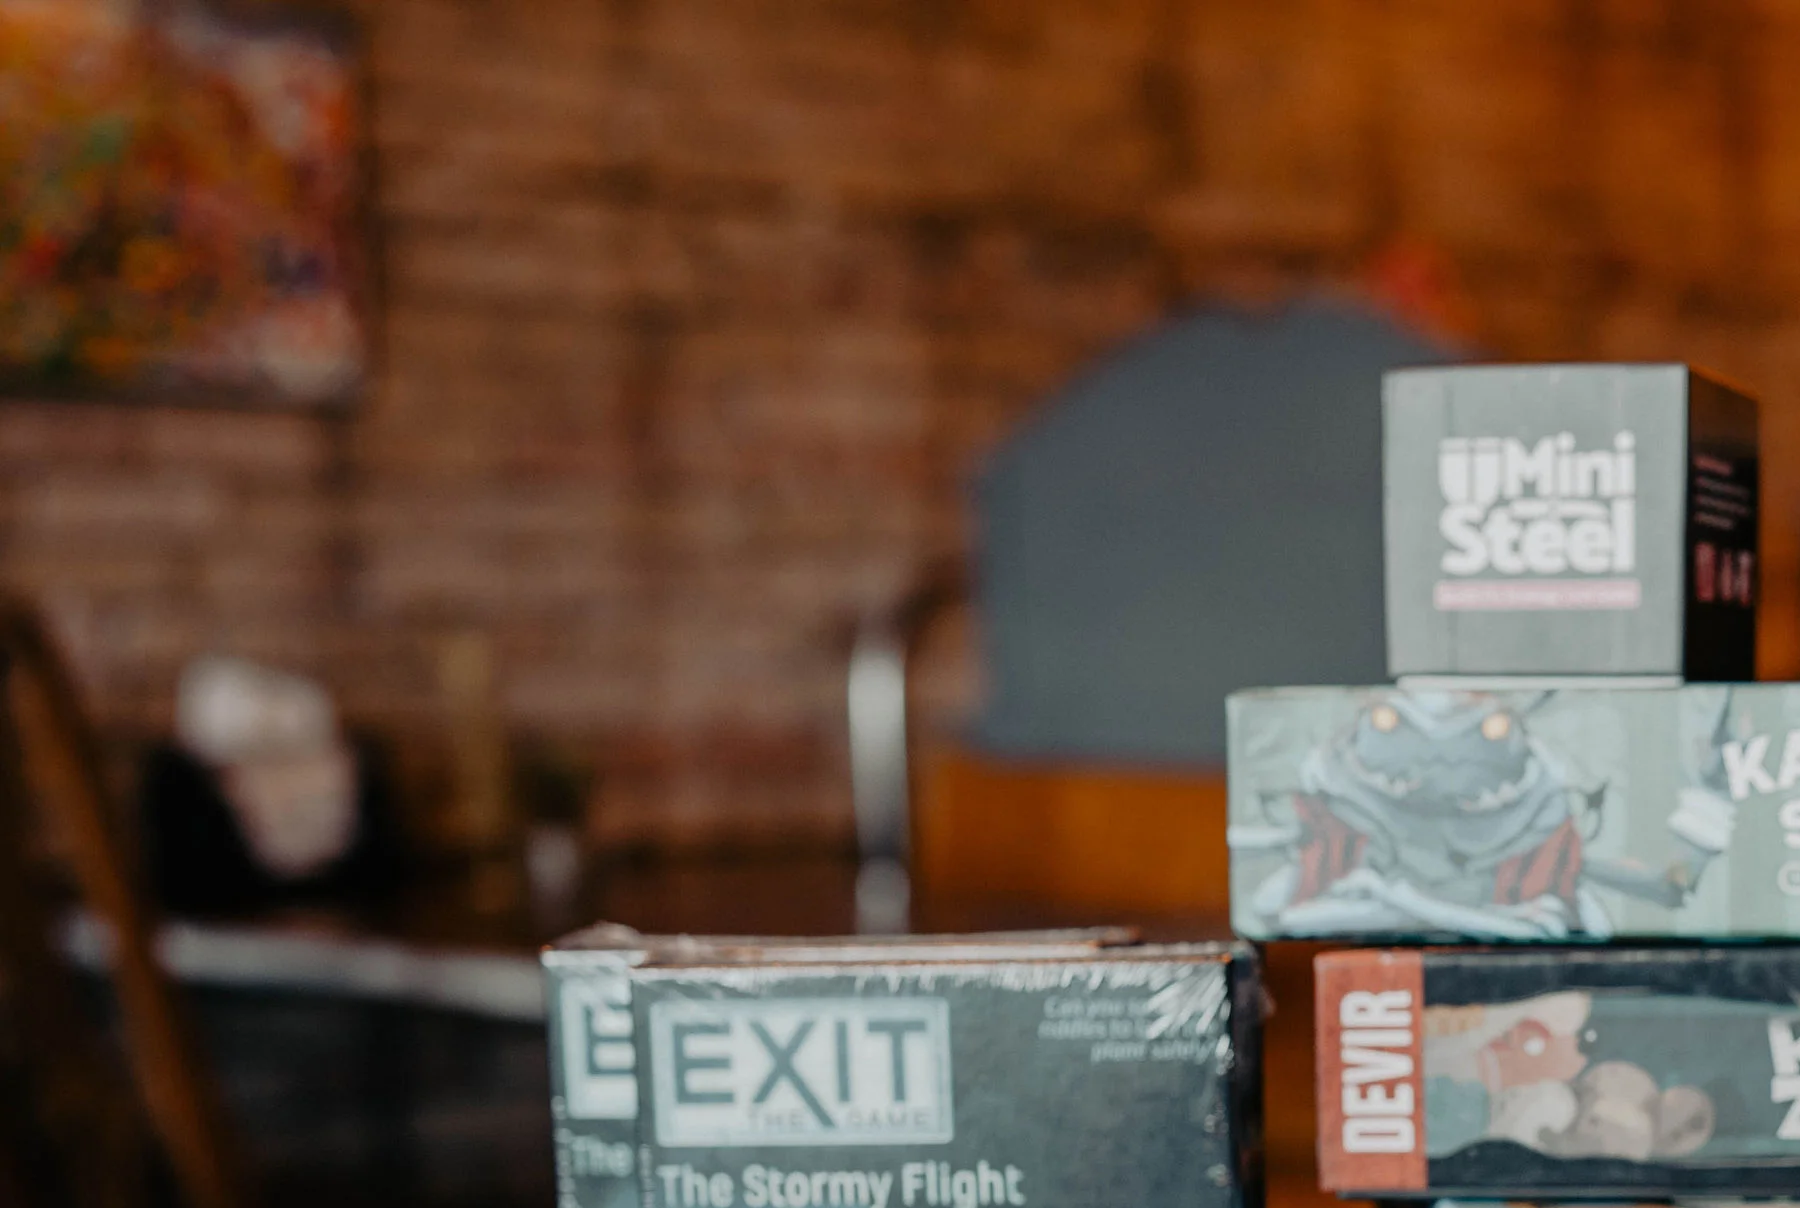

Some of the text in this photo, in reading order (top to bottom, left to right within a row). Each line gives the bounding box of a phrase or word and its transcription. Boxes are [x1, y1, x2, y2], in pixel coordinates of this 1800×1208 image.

[1503, 430, 1636, 498] Mini
[1438, 500, 1636, 575] Steel
[673, 1019, 928, 1129] EXIT
[1340, 988, 1415, 1154] DEVIR
[656, 1164, 736, 1208] The
